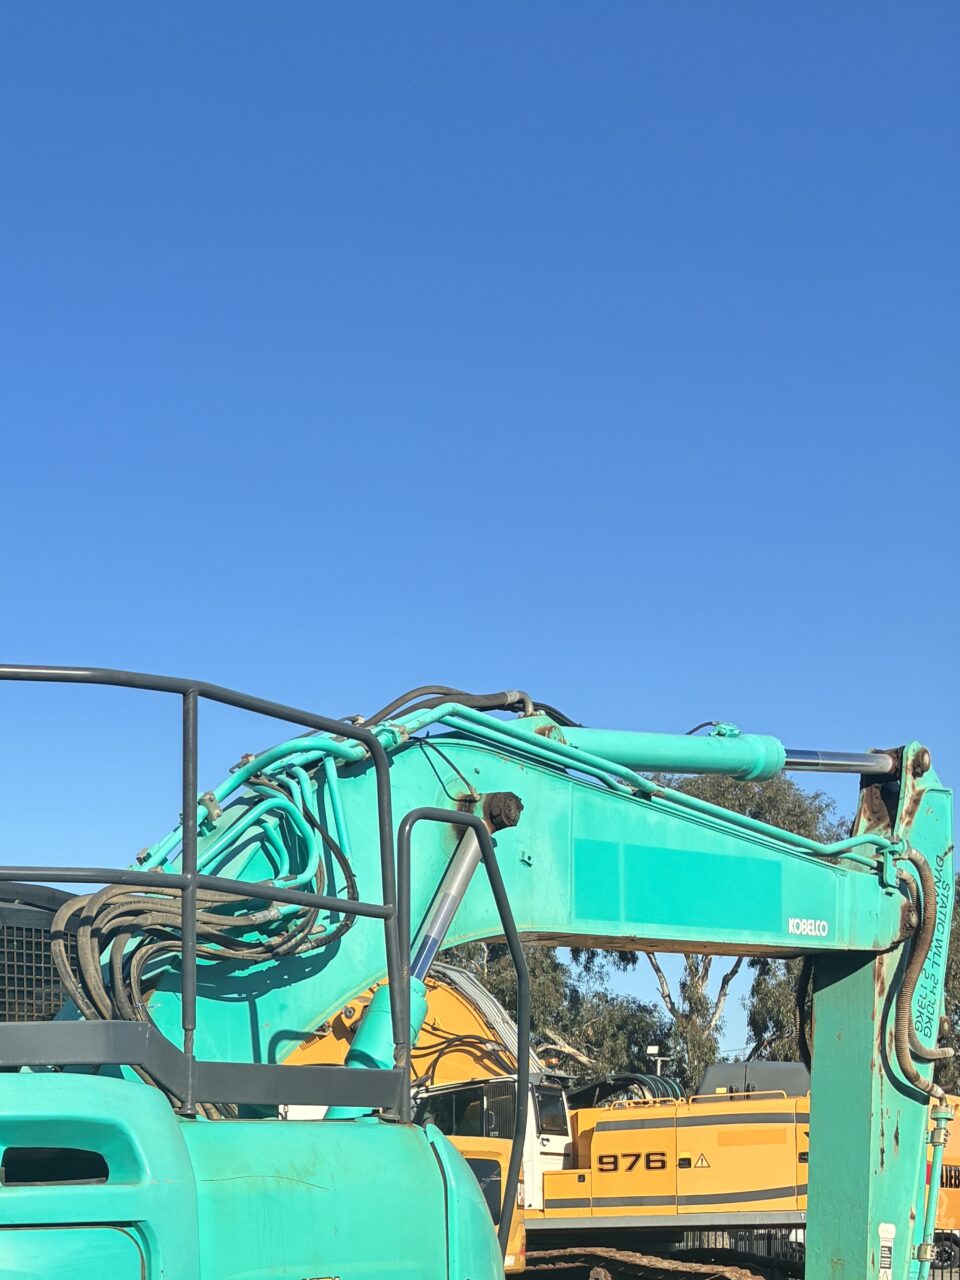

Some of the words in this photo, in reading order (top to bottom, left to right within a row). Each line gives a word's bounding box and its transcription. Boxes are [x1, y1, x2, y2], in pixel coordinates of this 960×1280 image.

[936, 880, 951, 935] STATIC
[788, 916, 829, 937] KOBELCO
[931, 938, 944, 969] WLL
[923, 973, 940, 1039] 2470KG
[597, 1151, 667, 1172] 976
